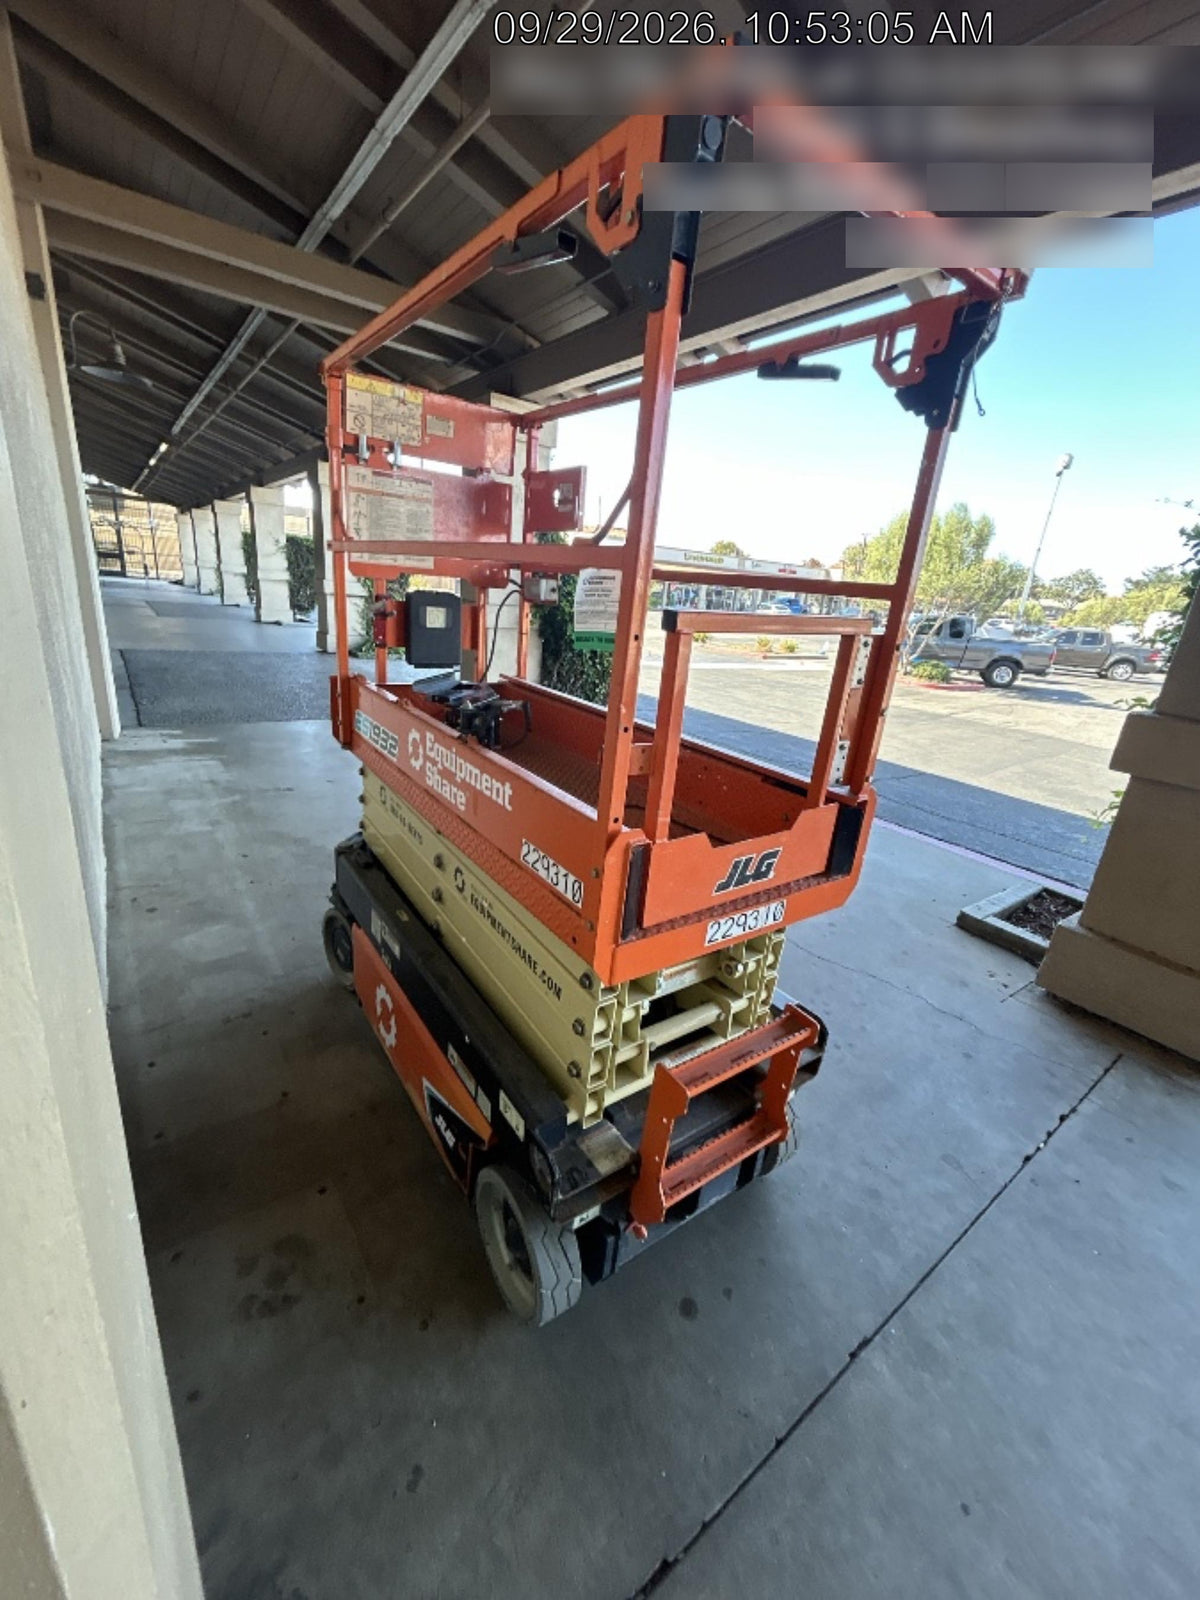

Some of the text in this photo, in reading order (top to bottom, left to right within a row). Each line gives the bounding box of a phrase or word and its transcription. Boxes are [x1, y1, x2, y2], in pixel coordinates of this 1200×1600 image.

[425, 760, 467, 811] Share
[426, 731, 513, 811] Equipment
[521, 839, 583, 907] 229310
[713, 847, 783, 894] JLG
[707, 900, 785, 945] 229310
